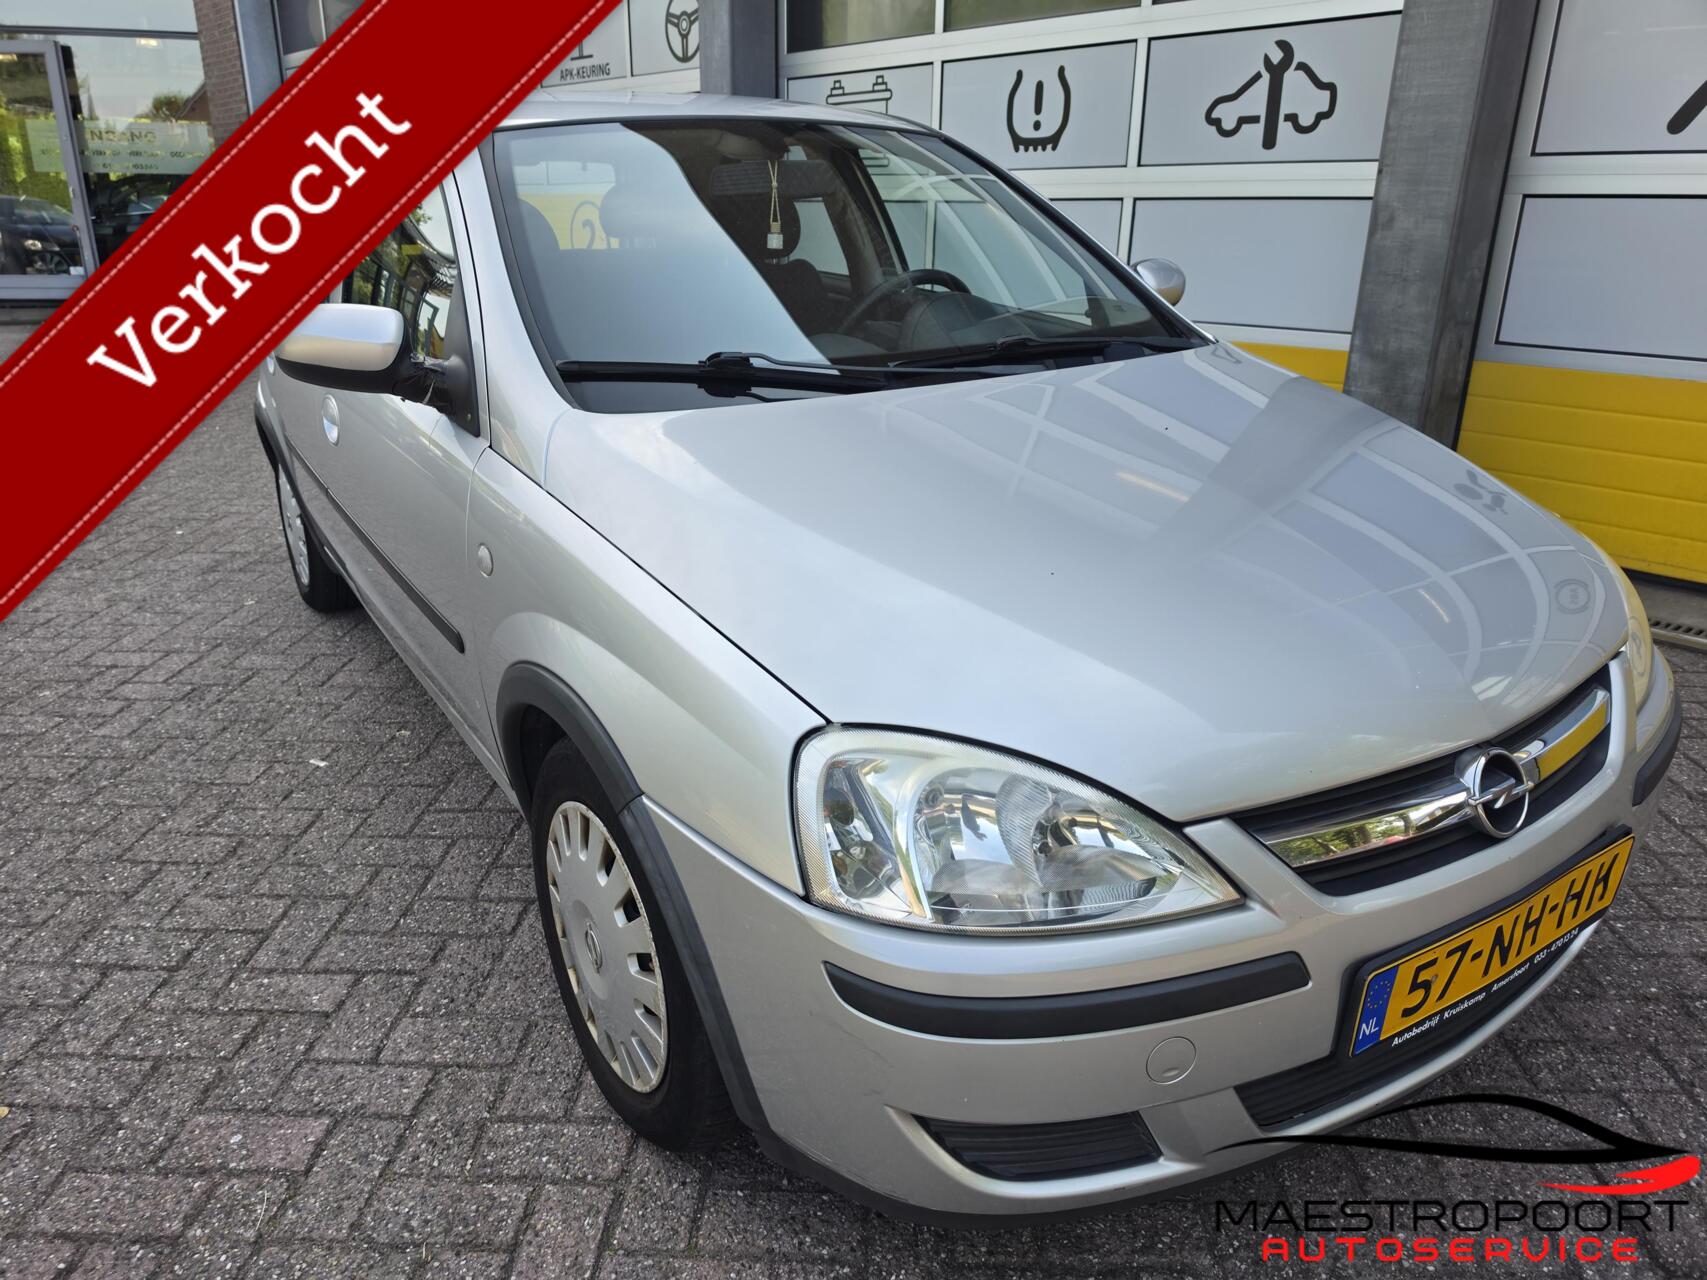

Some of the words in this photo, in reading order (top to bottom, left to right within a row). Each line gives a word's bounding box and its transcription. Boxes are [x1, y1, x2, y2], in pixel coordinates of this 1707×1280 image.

[560, 62, 610, 81] APK-KEURING
[1401, 852, 1620, 1019] 57-NH-HH
[1359, 1019, 1379, 1040] NL
[1392, 1014, 1440, 1046] Autobedrijf
[1443, 992, 1486, 1019] Kruiskamp
[1491, 962, 1530, 992] Amersfoort
